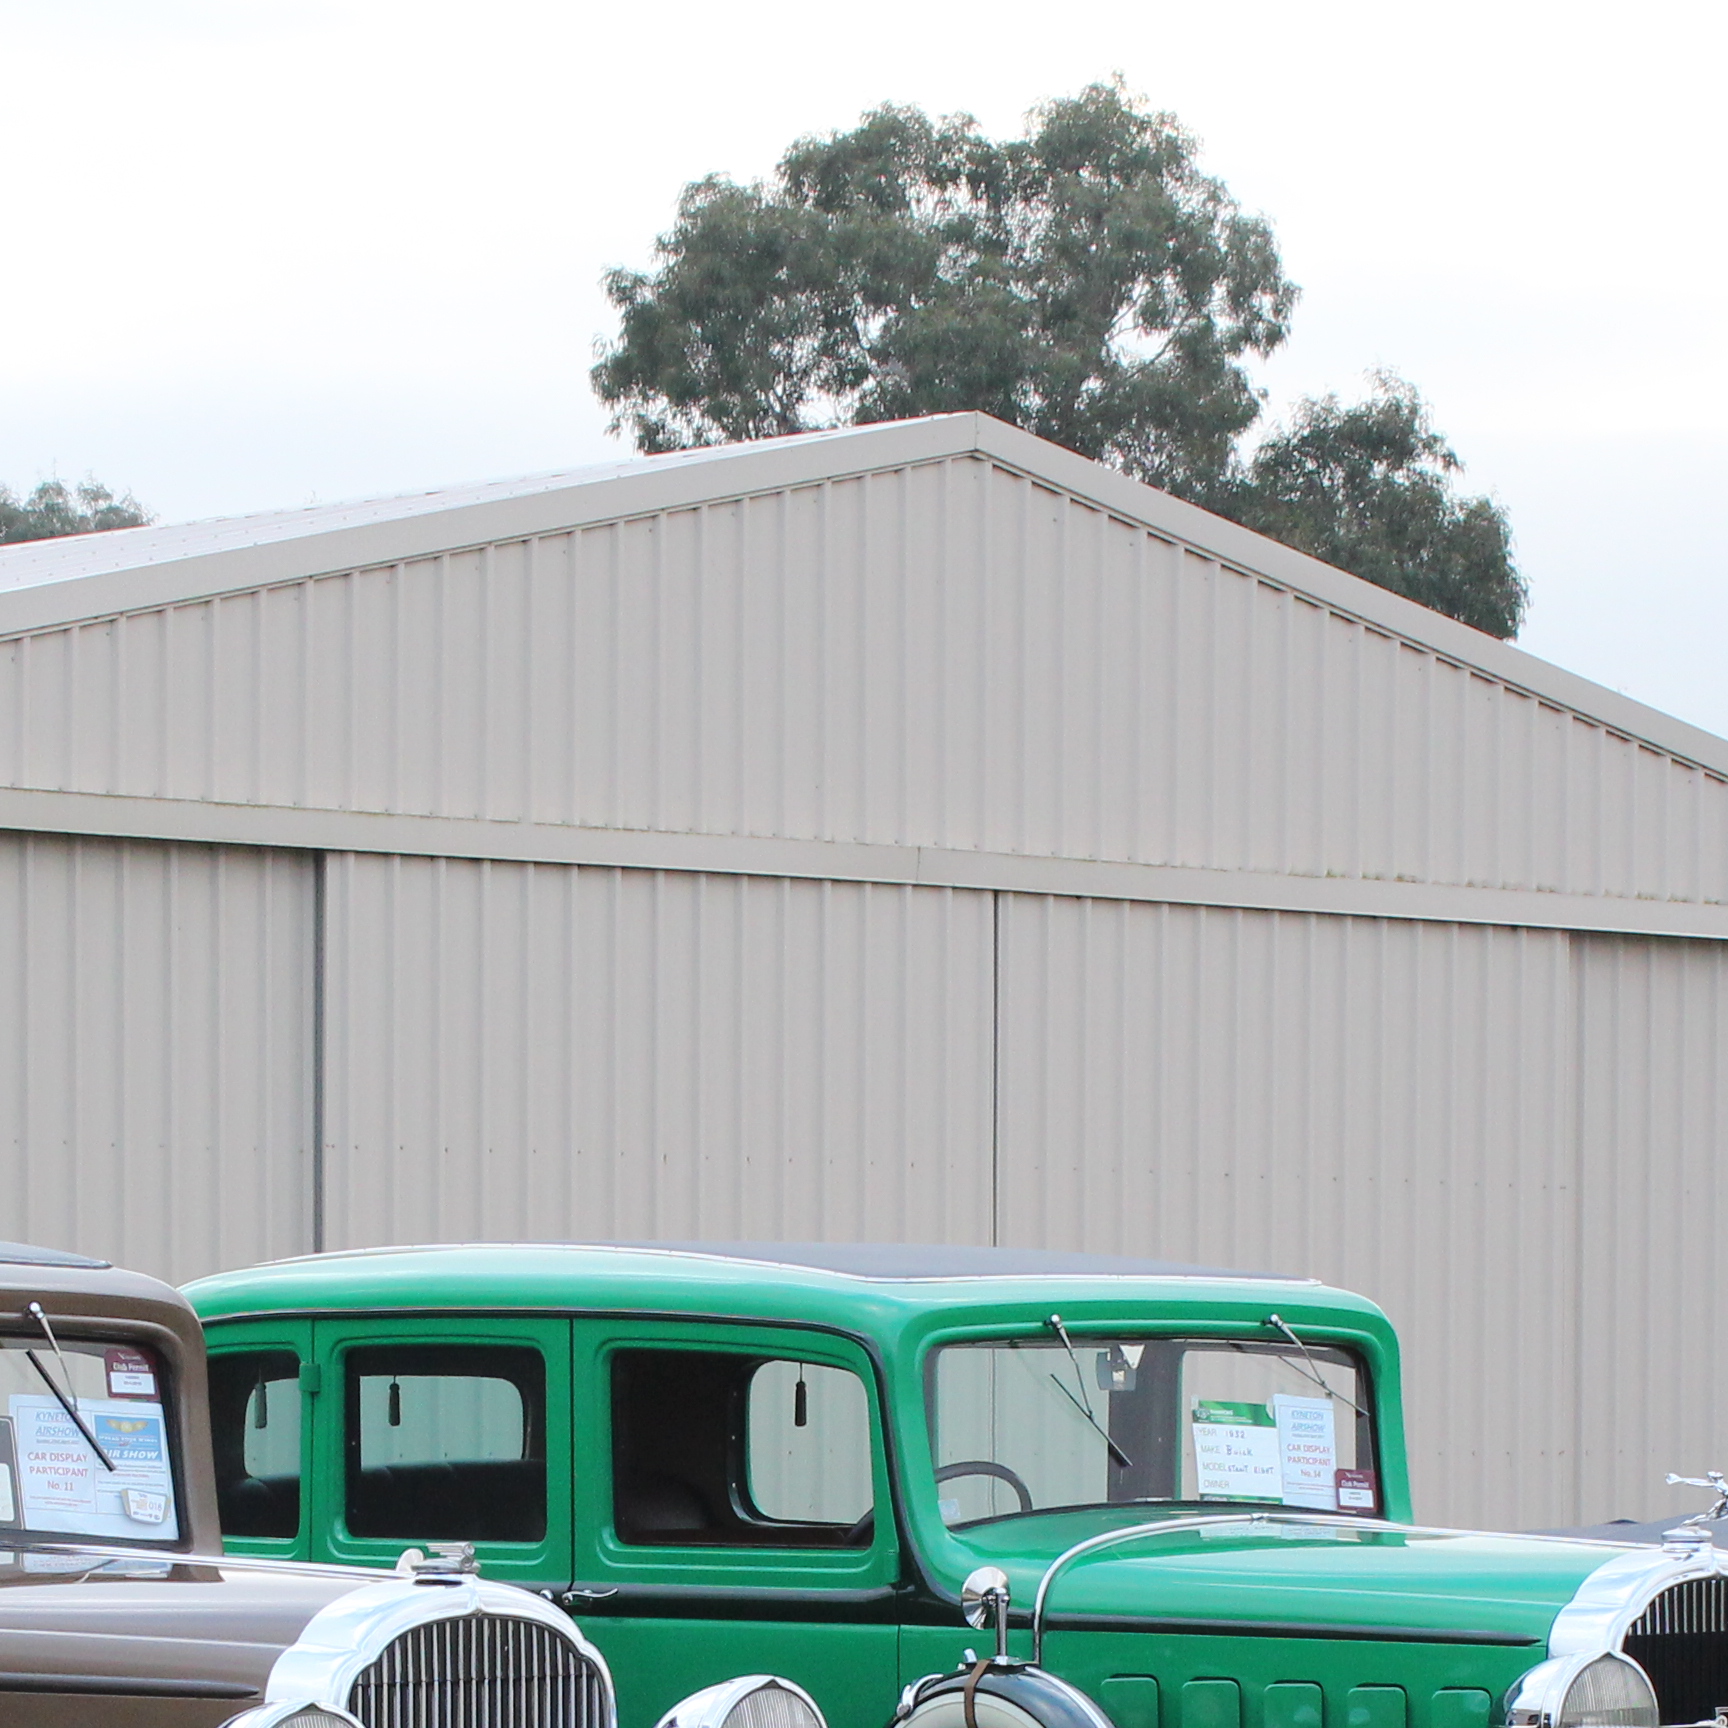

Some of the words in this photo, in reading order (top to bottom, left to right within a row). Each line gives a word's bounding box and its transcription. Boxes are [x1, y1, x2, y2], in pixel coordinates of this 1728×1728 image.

[35, 1410, 71, 1420] KYNETO
[35, 1426, 80, 1437] AIRSHOW
[1225, 1430, 1245, 1439] 1932
[1287, 1443, 1301, 1452] CAR
[1303, 1444, 1331, 1453] DISPLAY
[27, 1452, 47, 1461] CAR
[49, 1453, 88, 1463] DISPLAY
[122, 1450, 159, 1459] SHOW
[1287, 1456, 1331, 1466] PARTICIPANT
[29, 1466, 89, 1477] PARTICIPANT
[47, 1481, 62, 1491] No.
[64, 1482, 74, 1491] 11
